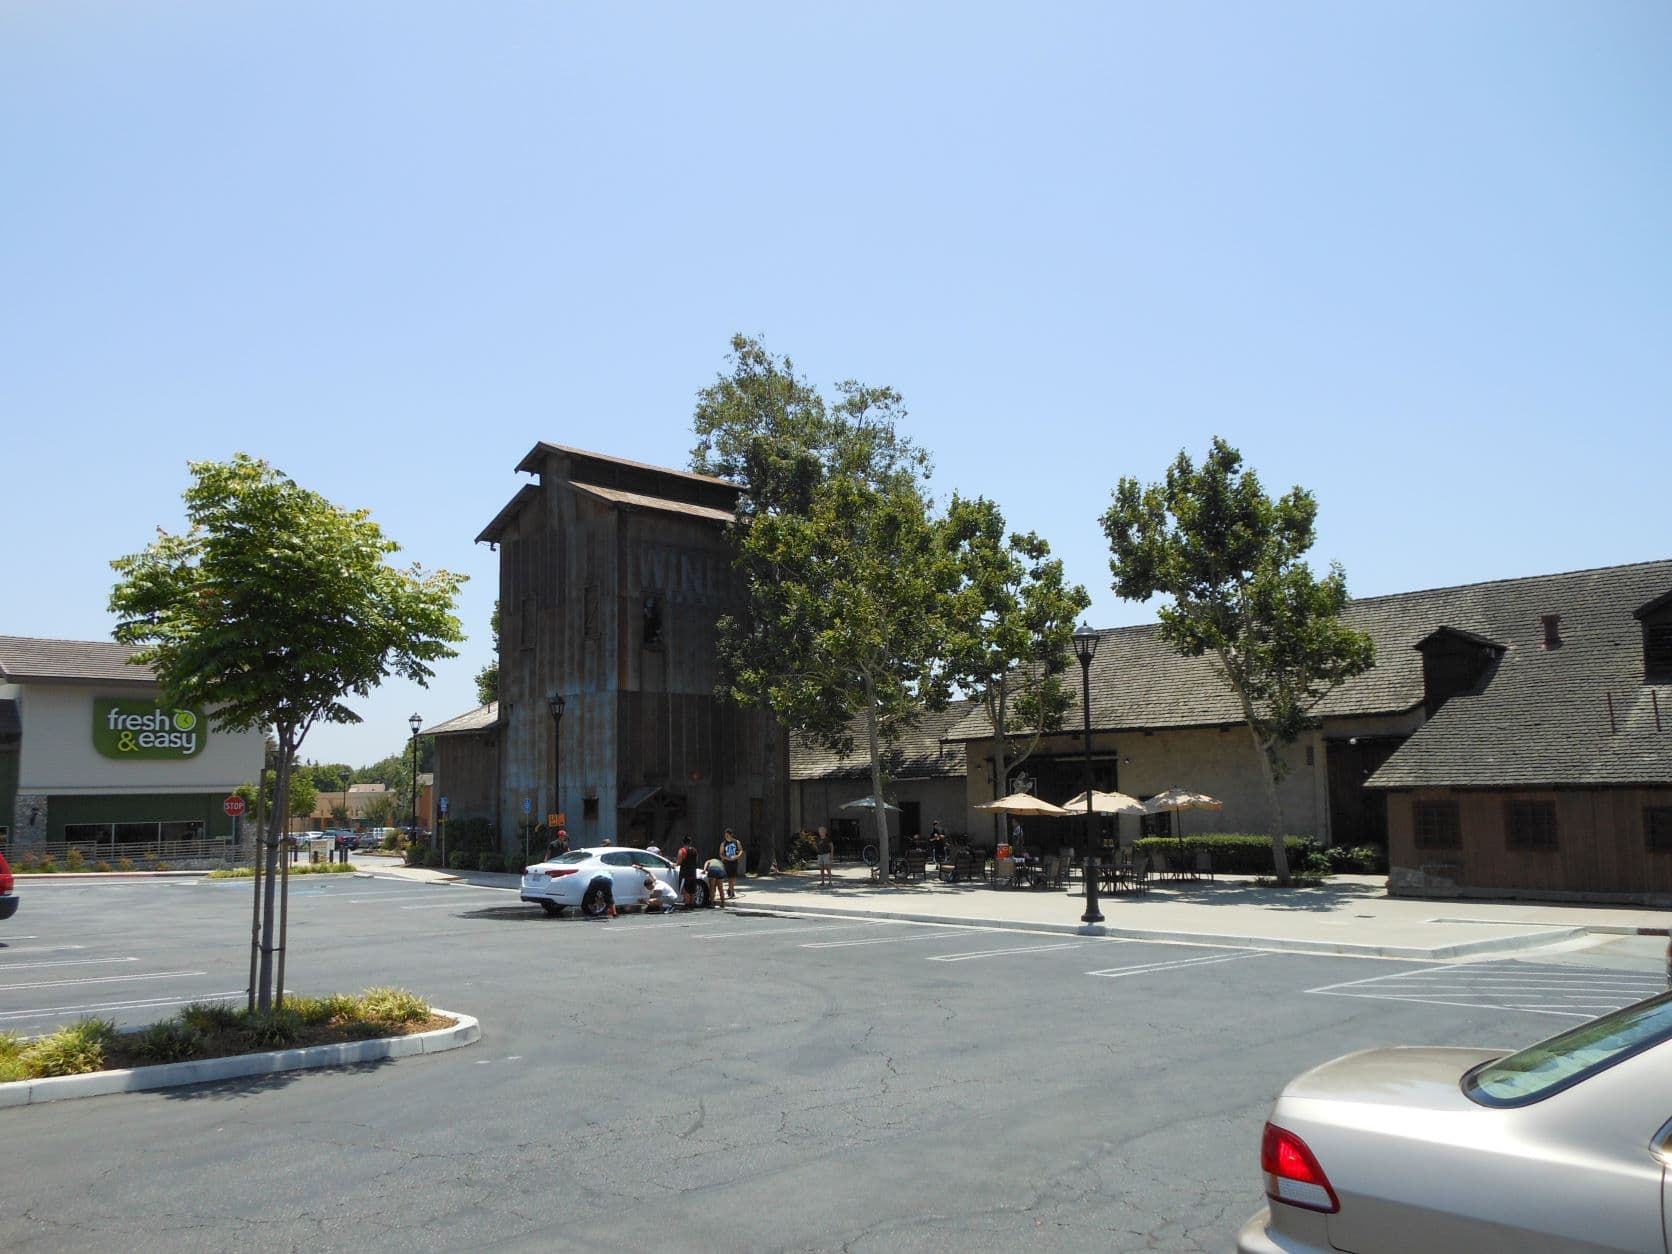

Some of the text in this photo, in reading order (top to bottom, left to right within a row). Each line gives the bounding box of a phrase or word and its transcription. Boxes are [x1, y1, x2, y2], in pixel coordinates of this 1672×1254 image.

[108, 707, 170, 731] fresh
[118, 731, 197, 755] & easy
[225, 802, 244, 810] STOP
